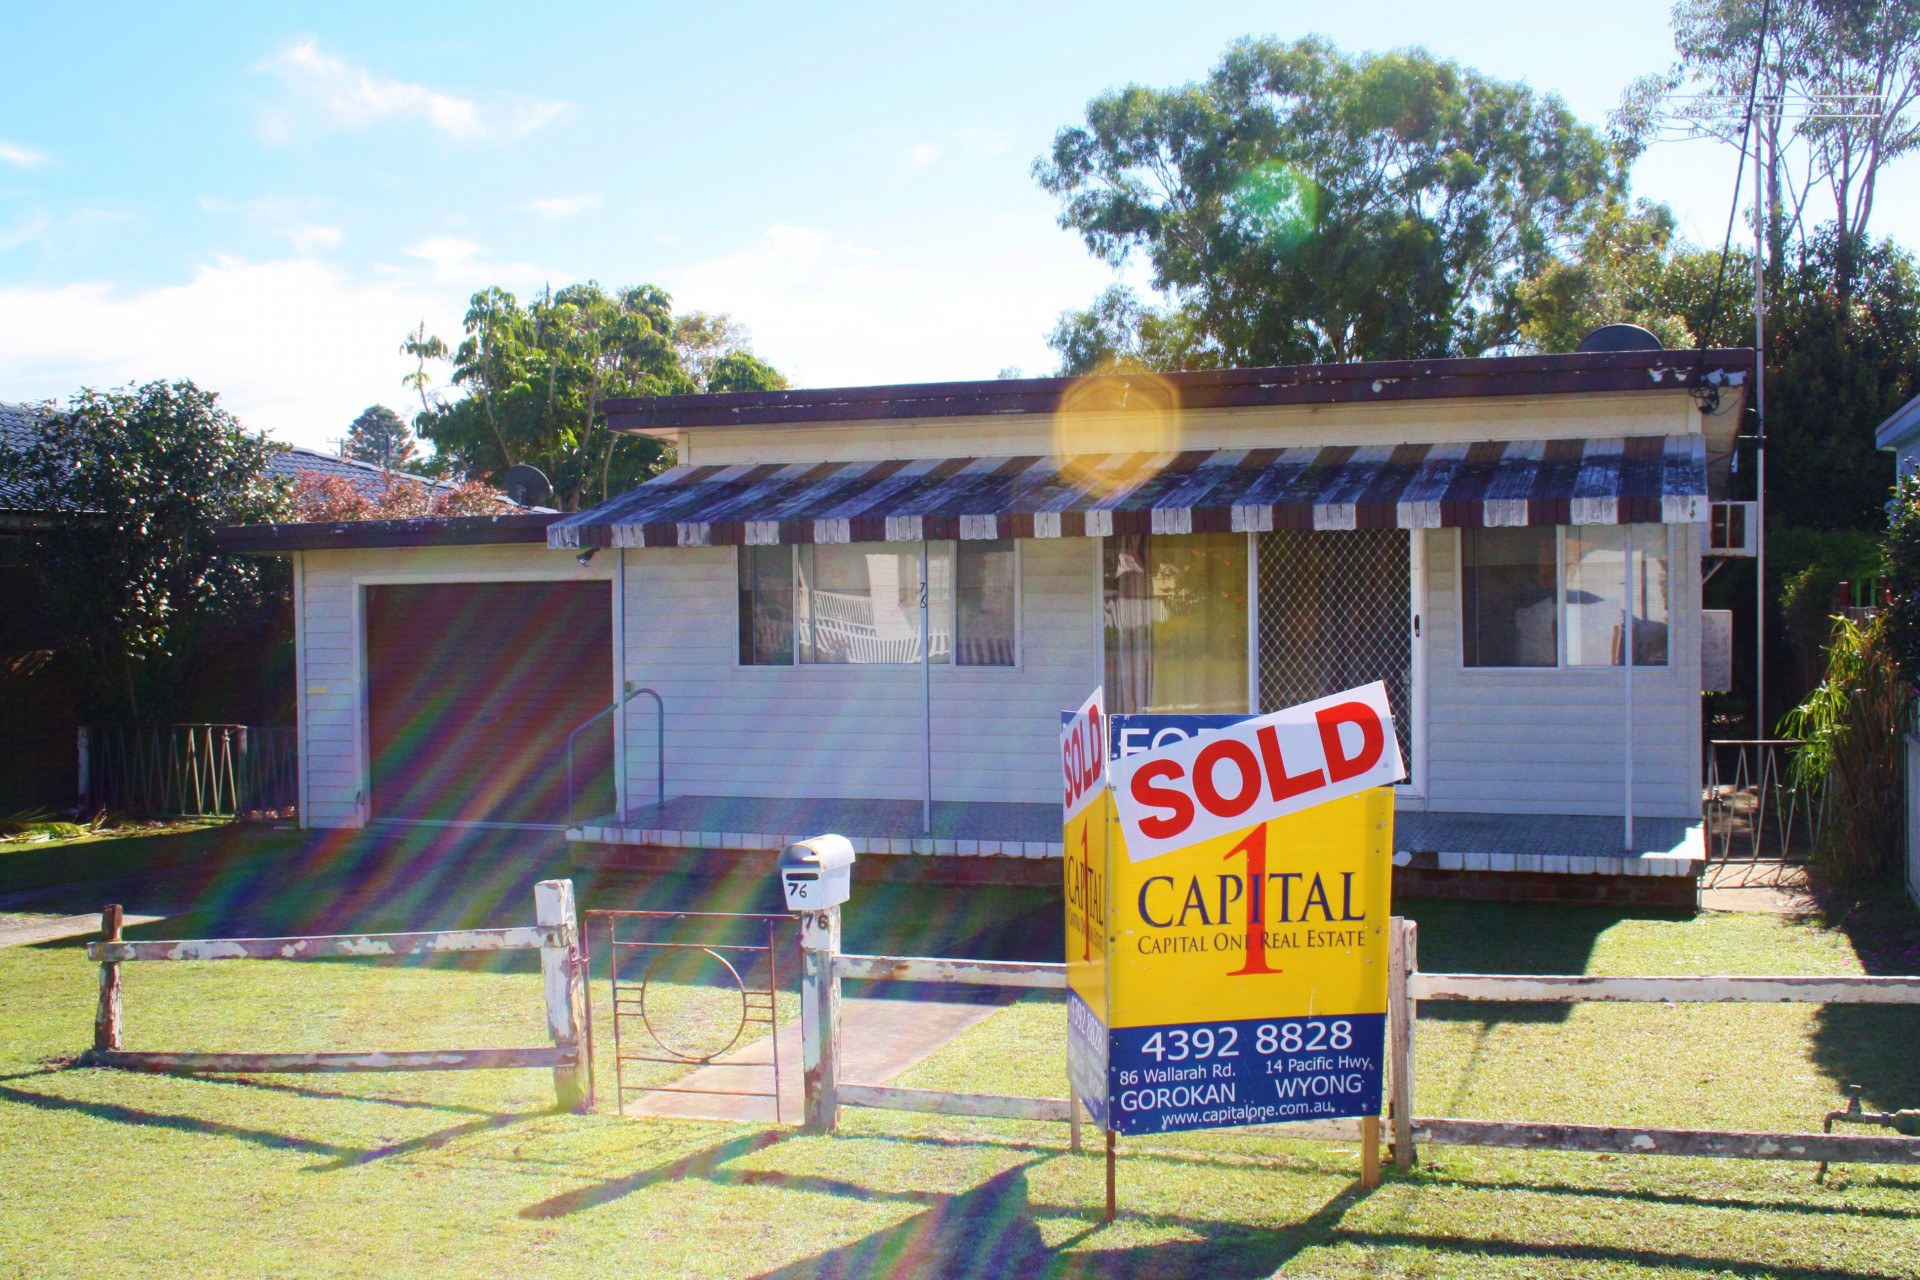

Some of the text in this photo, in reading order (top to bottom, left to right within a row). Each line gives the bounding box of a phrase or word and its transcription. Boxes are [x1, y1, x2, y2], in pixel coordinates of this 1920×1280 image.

[920, 582, 927, 608] 76
[1063, 704, 1102, 808] SOLD
[1130, 702, 1384, 839] SOLD
[788, 883, 807, 898] 76
[1068, 856, 1103, 926] CAPITAL
[1137, 872, 1366, 928] CAPITAL
[804, 914, 828, 930] 76
[1071, 995, 1085, 1034] 4392
[1087, 1012, 1102, 1055] 8828
[1141, 1021, 1353, 1062] 4392 8828
[1120, 1070, 1139, 1086] 86
[1143, 1065, 1207, 1083] Wallarah
[1212, 1063, 1236, 1078] Rd.
[1265, 1060, 1283, 1074] 14
[1288, 1057, 1334, 1072] Pacific
[1120, 1082, 1236, 1112] GOROKAN
[1275, 1073, 1362, 1099] WYONG
[1161, 1101, 1331, 1126] www.capitalone.com.au
